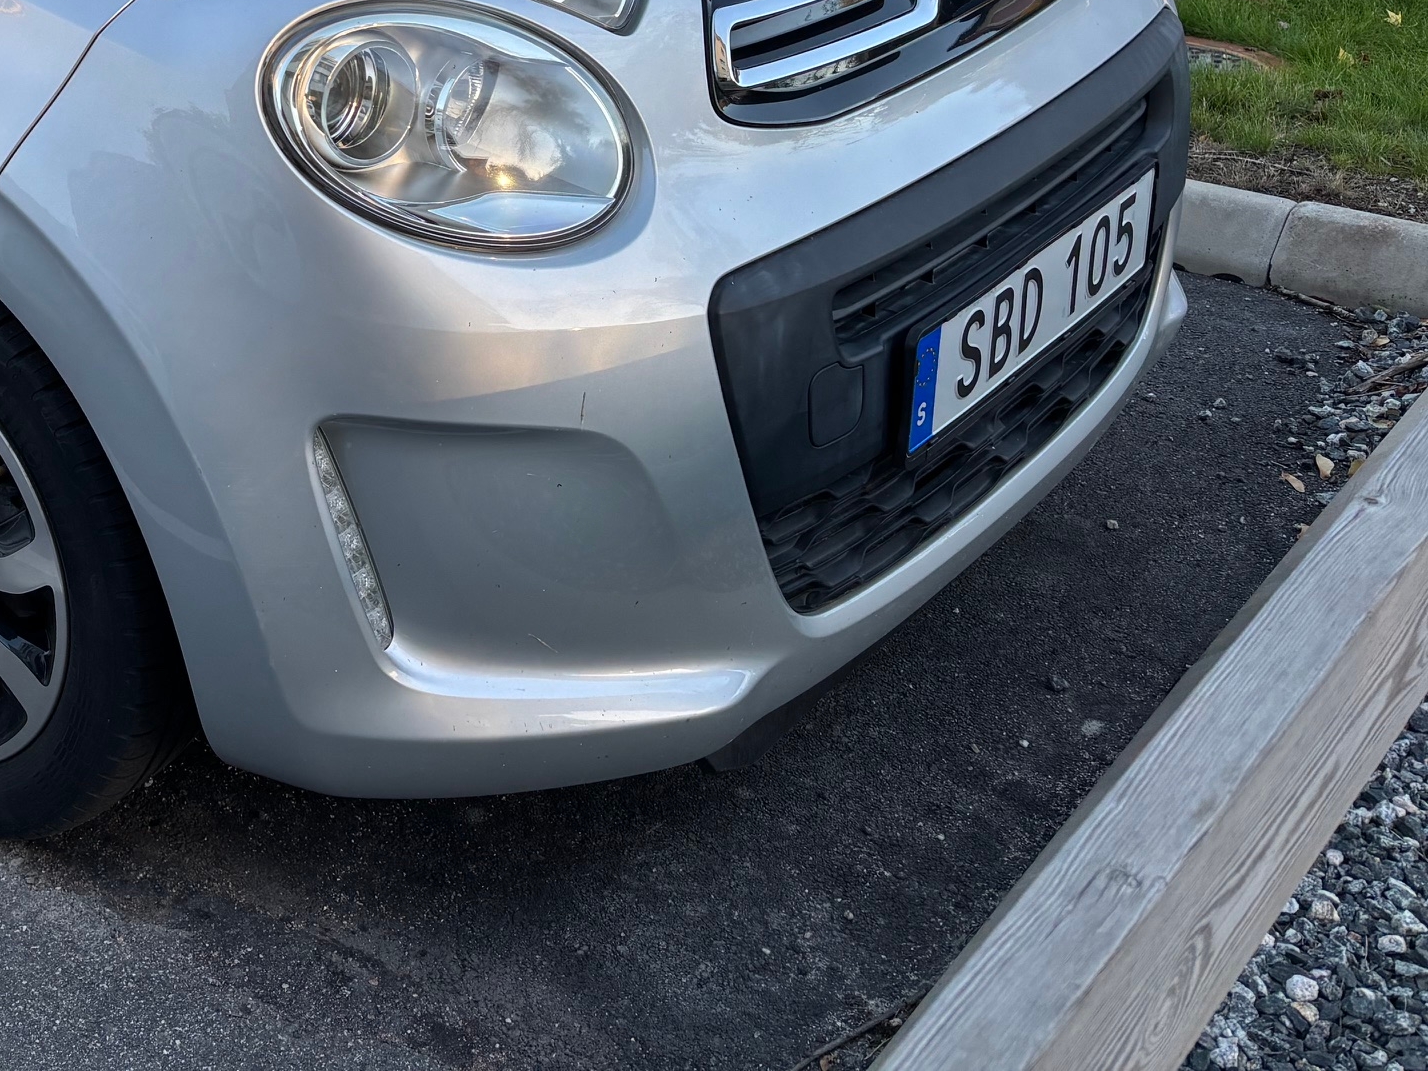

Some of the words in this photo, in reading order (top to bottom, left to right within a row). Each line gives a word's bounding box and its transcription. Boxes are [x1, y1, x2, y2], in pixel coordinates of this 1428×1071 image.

[956, 267, 1044, 399] SBD
[1065, 191, 1137, 316] 105
[916, 402, 927, 427] S
